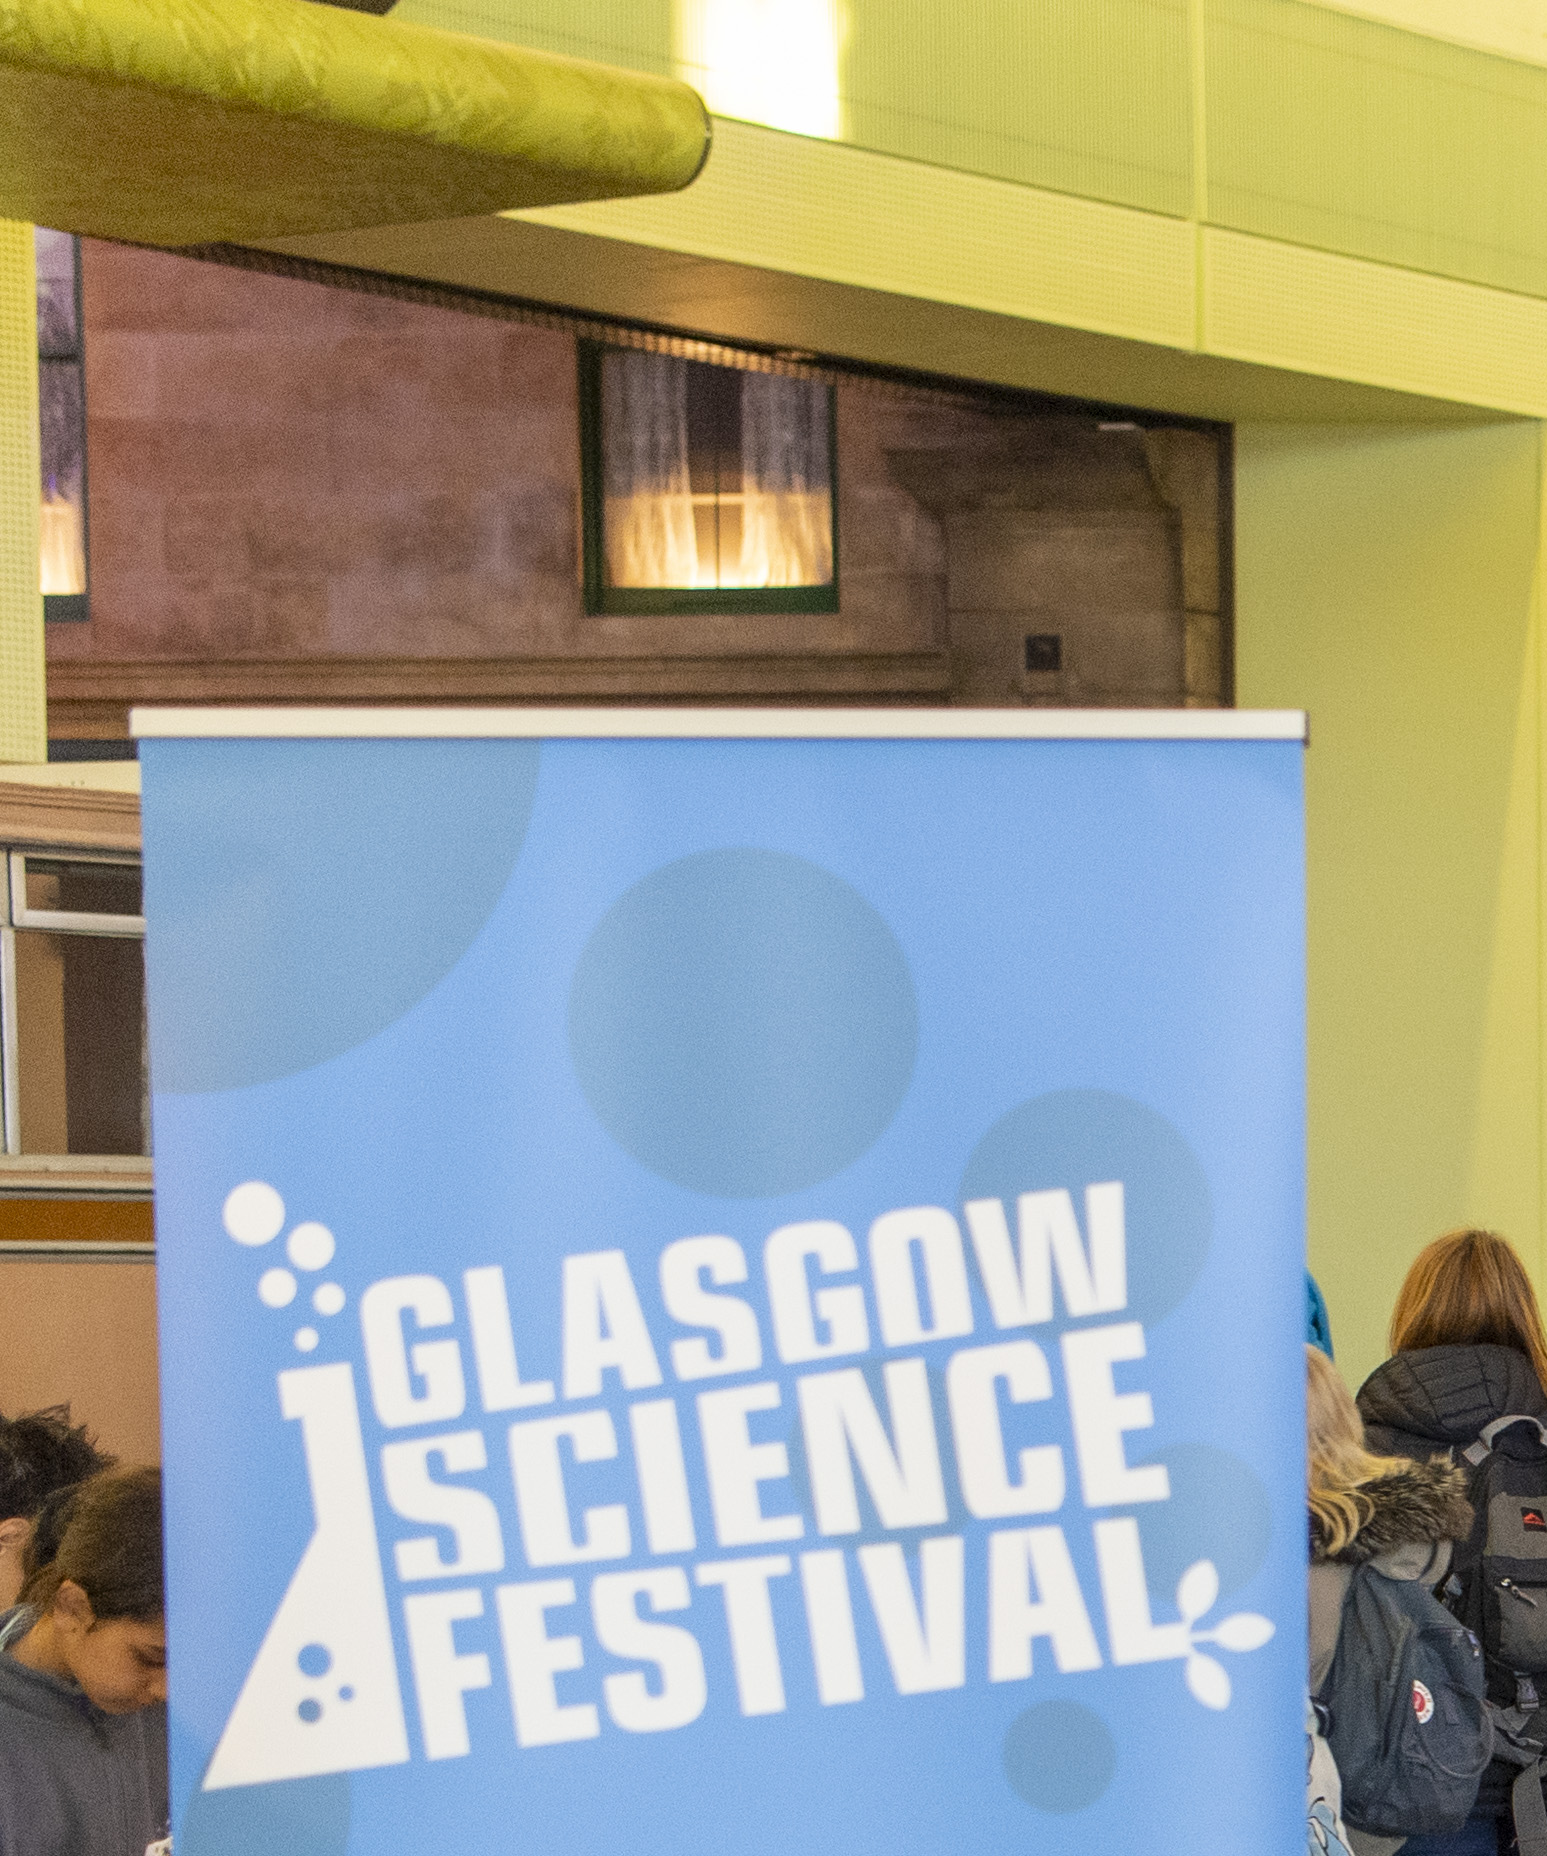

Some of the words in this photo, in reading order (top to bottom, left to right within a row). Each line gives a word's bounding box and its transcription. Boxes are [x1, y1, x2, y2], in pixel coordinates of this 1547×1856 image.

[358, 1180, 1130, 1429] GLASGOW
[380, 1321, 1172, 1582] SCIENCE
[404, 1515, 1193, 1762] FESTIVAL
